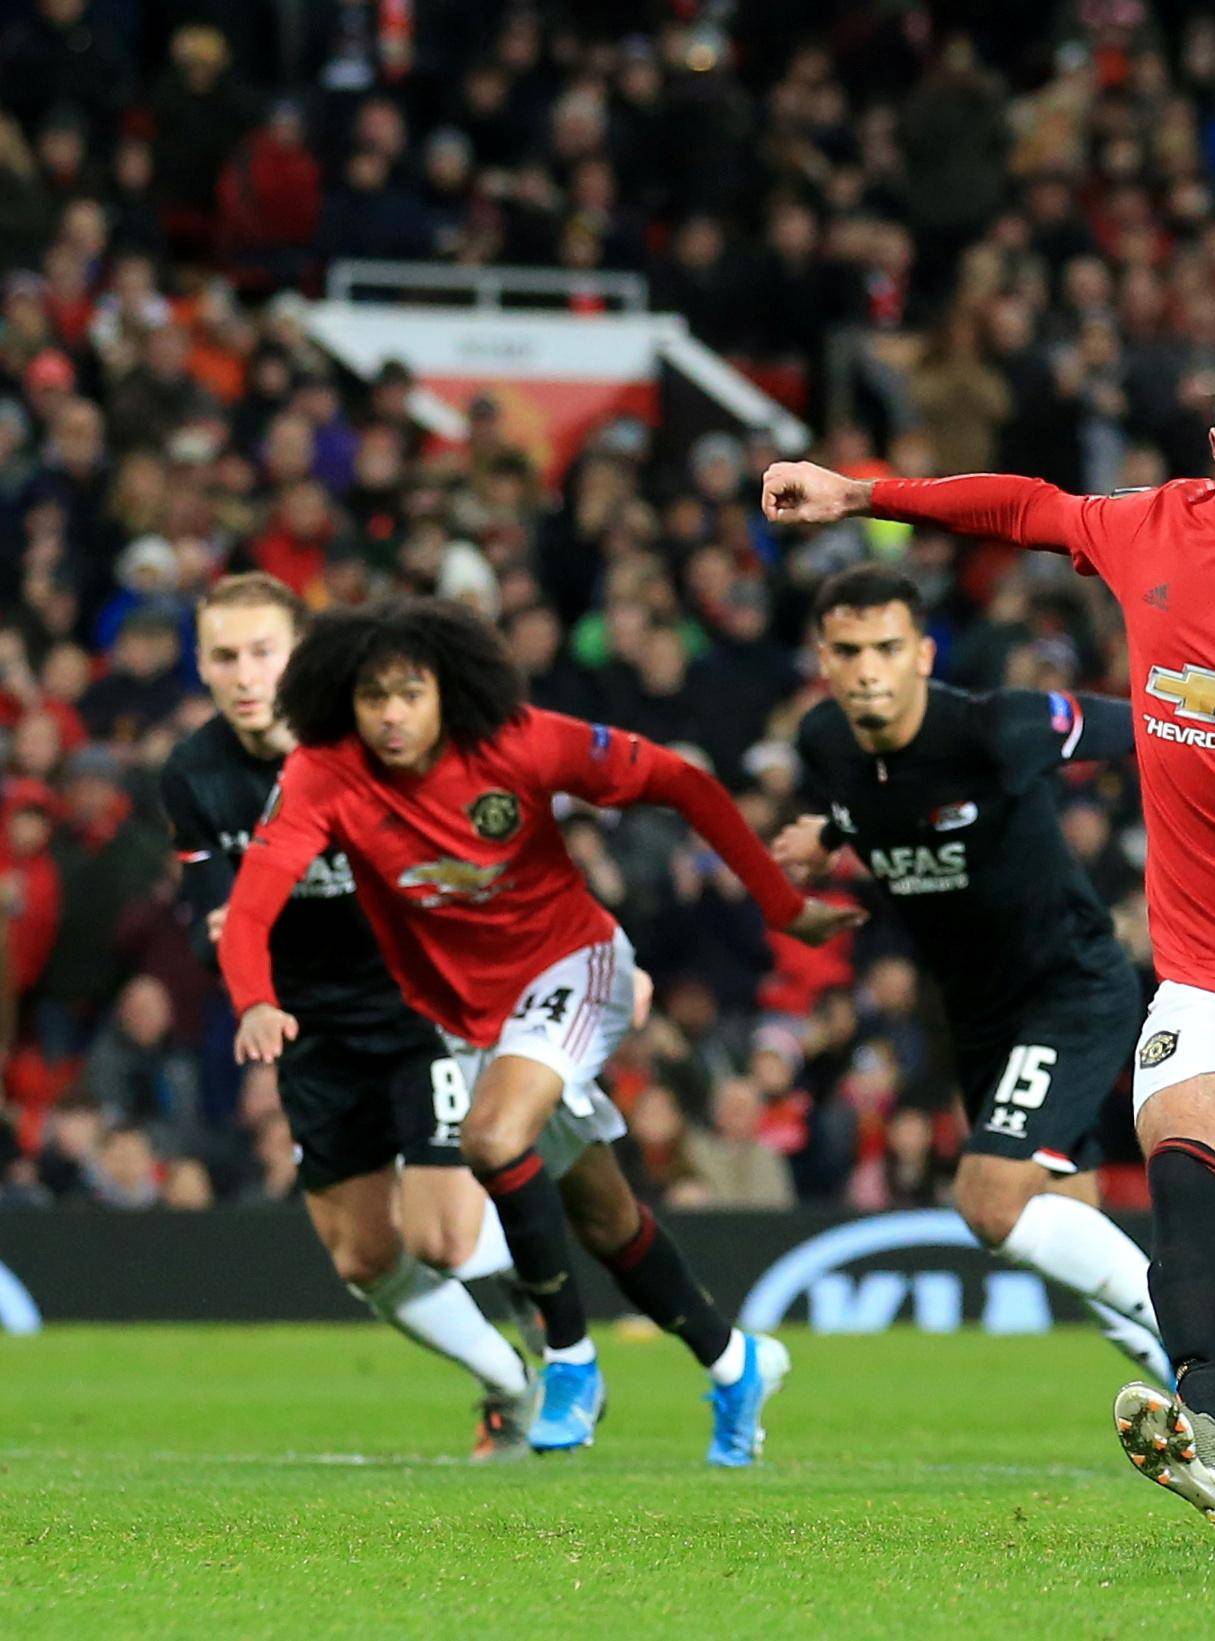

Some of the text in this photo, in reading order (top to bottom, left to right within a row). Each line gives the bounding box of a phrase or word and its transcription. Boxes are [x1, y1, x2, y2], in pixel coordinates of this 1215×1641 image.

[870, 841, 966, 879] AFAS
[430, 1056, 471, 1122] 8
[995, 1045, 1058, 1109] 15
